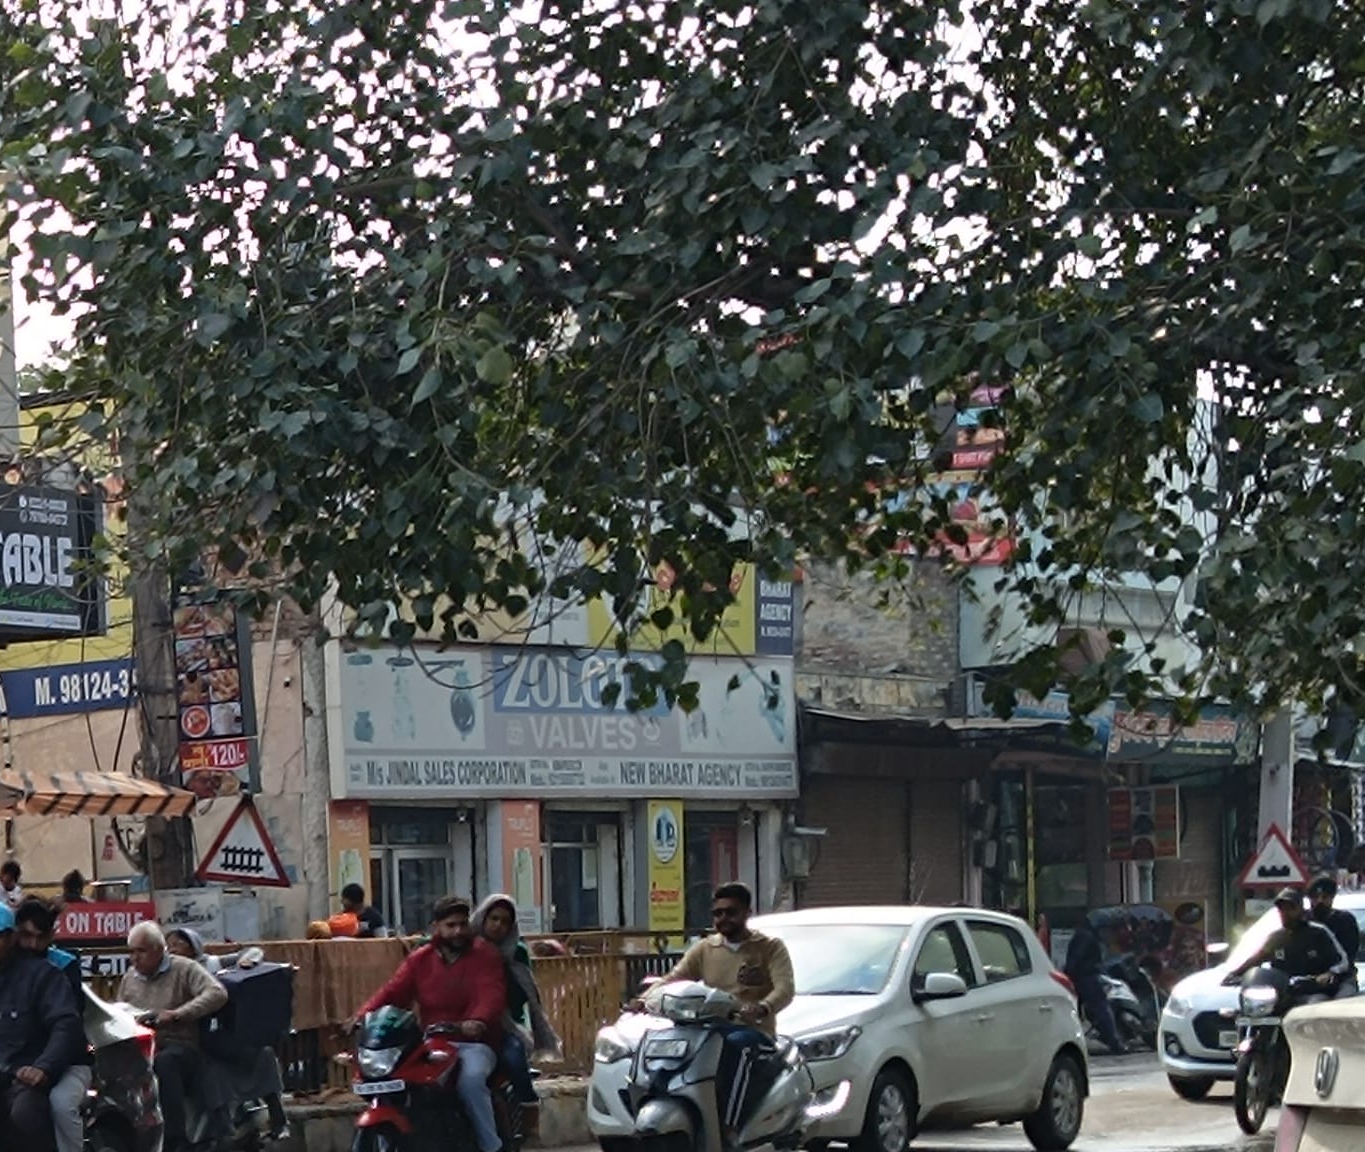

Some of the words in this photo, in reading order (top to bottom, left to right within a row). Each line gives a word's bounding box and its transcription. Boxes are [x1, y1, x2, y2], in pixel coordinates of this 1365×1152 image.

[35, 677, 56, 705] M.
[501, 653, 657, 709] ZOLOT
[530, 716, 637, 750] VALVES
[424, 760, 457, 785] SALES
[458, 760, 527, 785] CORPORATION
[620, 761, 646, 785] NEW
[648, 762, 694, 785] BHARAT
[697, 762, 742, 786] AGENCY
[66, 911, 90, 933] ON
